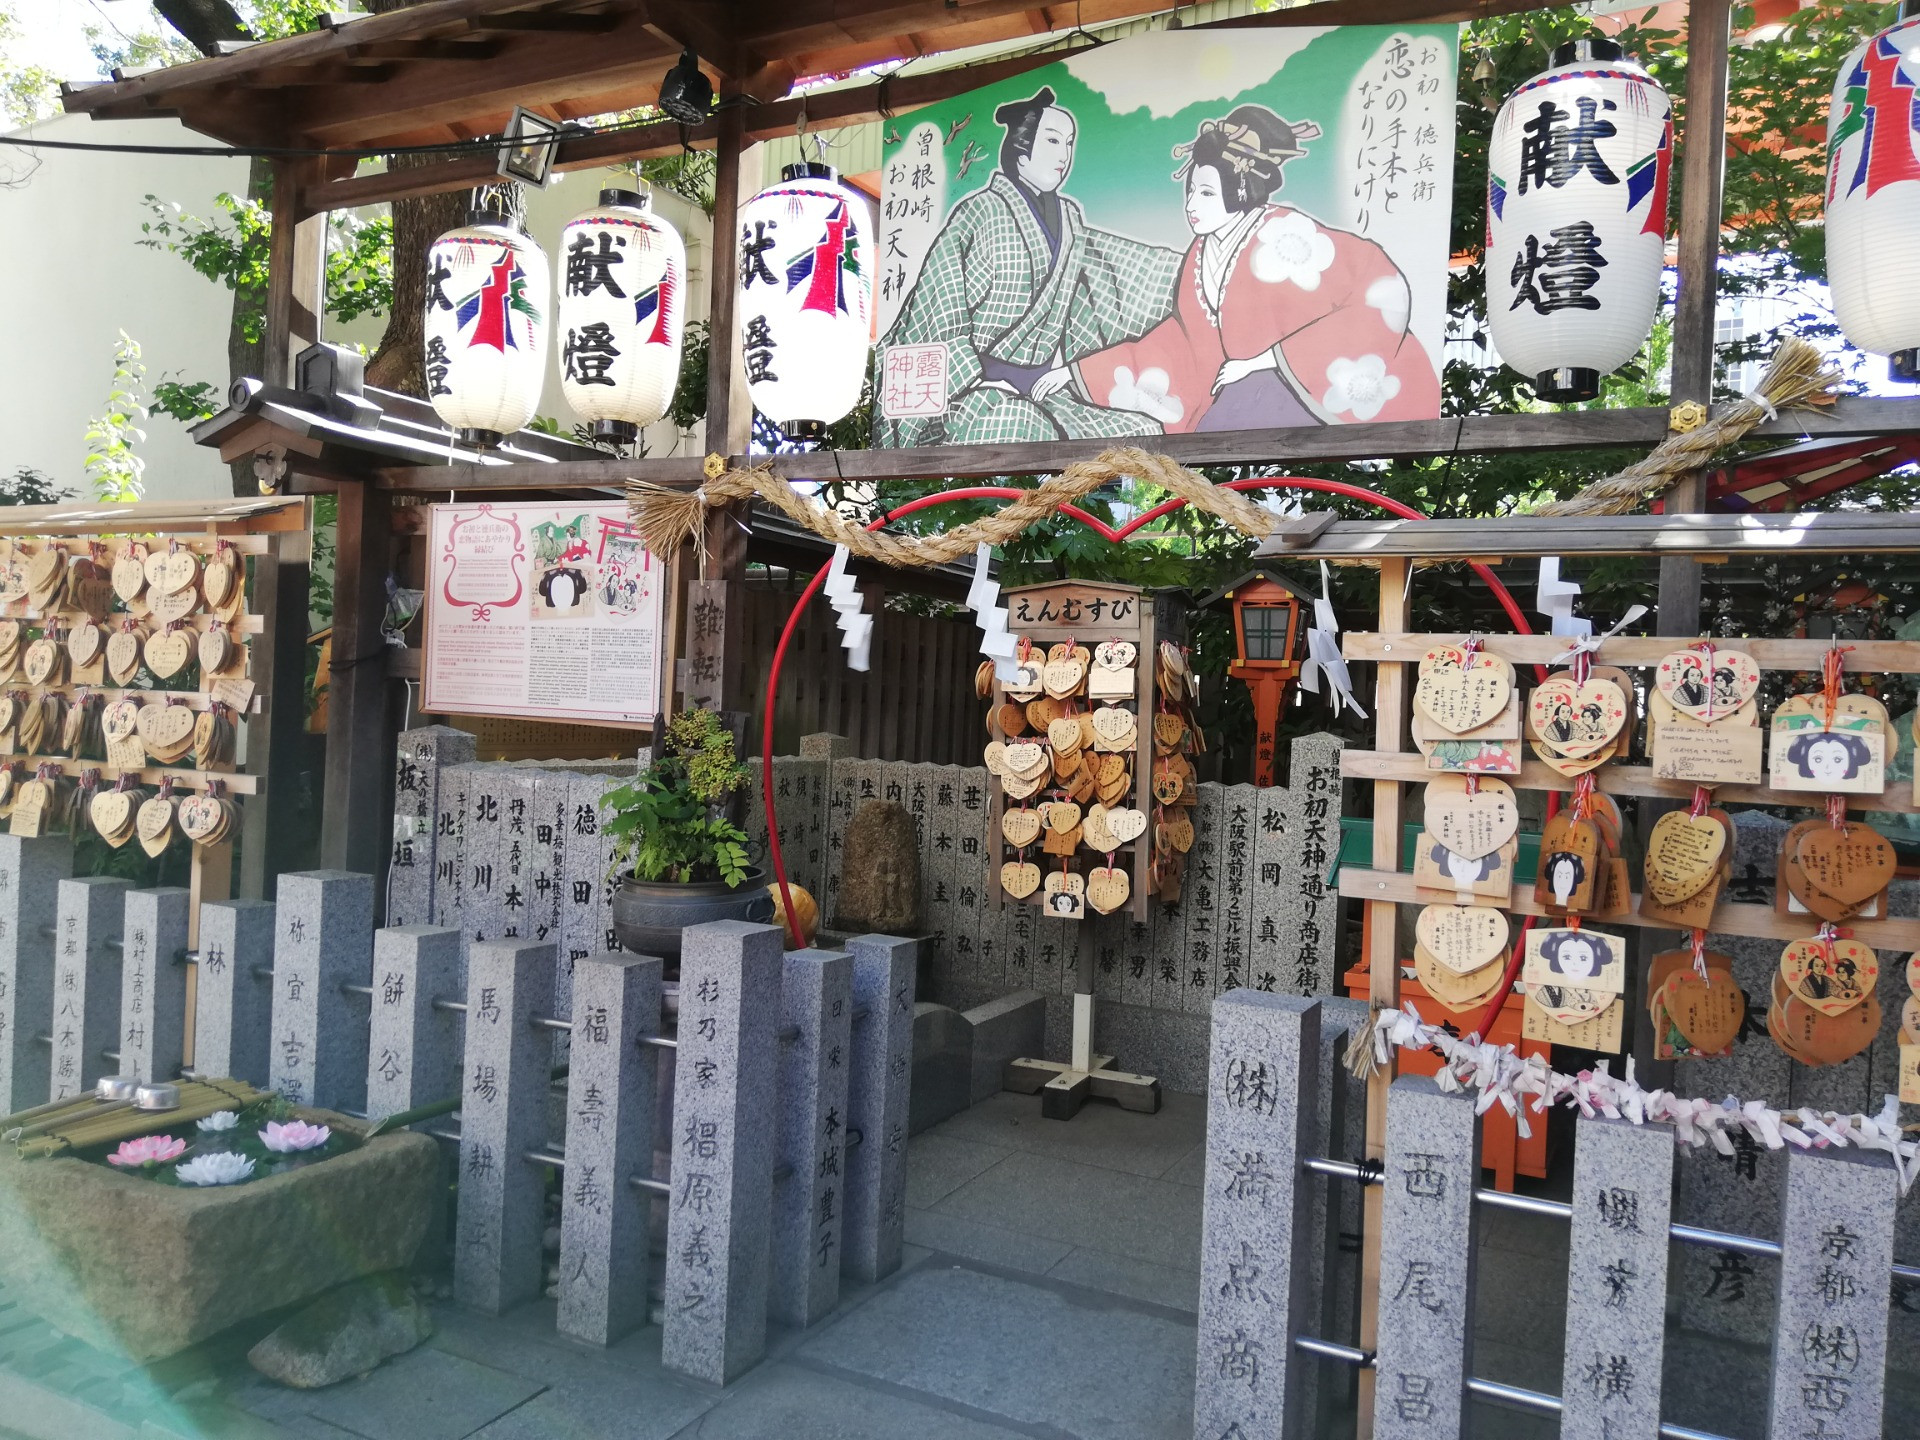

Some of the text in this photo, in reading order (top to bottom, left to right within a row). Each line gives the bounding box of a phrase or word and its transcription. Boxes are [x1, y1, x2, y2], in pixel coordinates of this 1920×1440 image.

[1354, 80, 1383, 234] なりにけり
[1380, 37, 1415, 214] 恋の手本と
[882, 162, 909, 303] お初天神
[1016, 596, 1136, 623] えんむすび
[393, 759, 418, 927] 板垣
[438, 811, 456, 927] 北川
[473, 794, 499, 942] 北川
[206, 942, 226, 975] 林
